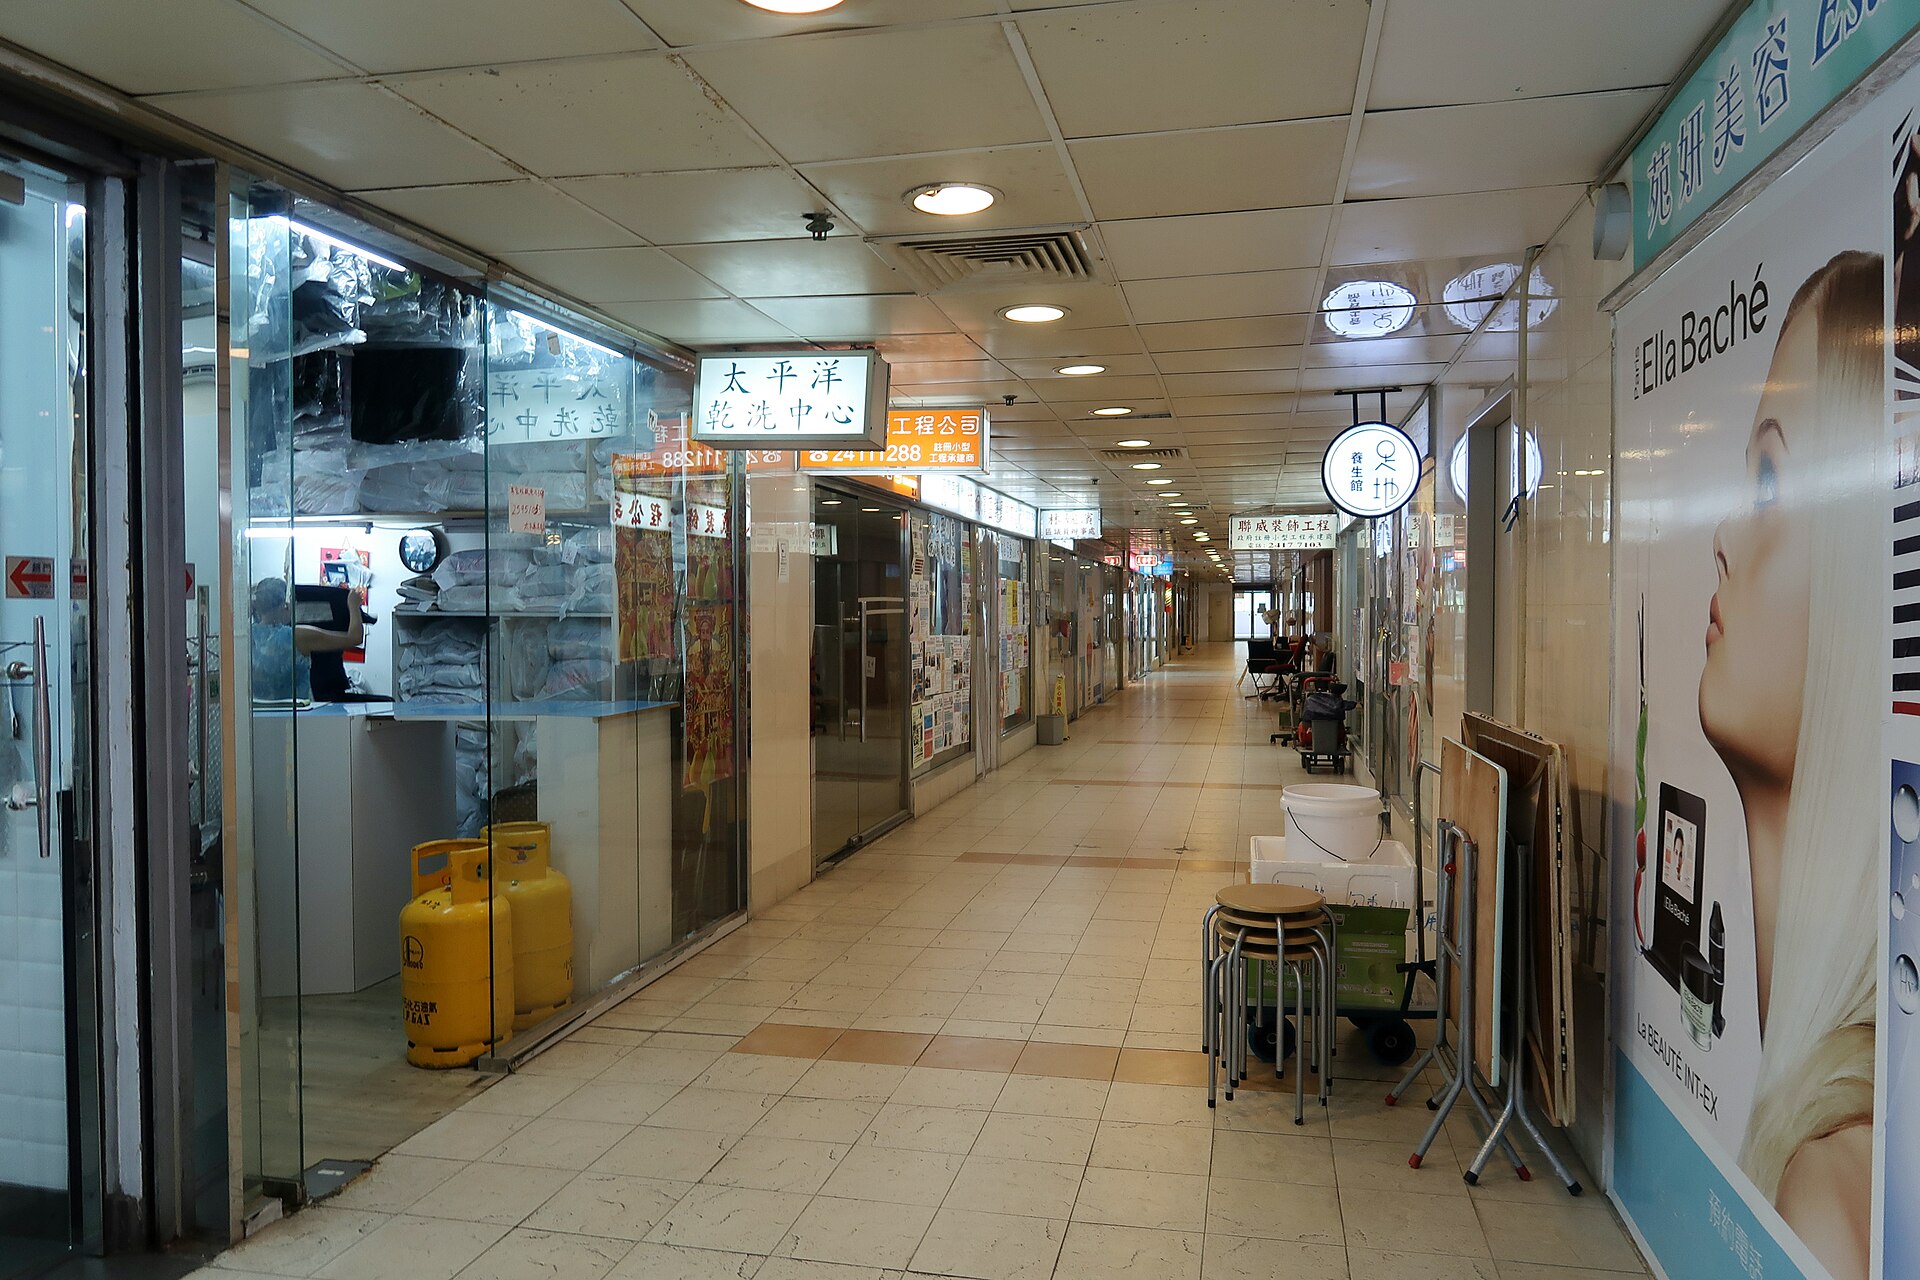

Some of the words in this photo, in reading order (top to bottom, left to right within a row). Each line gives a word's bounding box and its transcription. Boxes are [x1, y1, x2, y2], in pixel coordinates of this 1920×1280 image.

[1648, 16, 1790, 236] 苑妍美容
[1643, 337, 1676, 395] Ella
[1682, 262, 1769, 373] Baché
[720, 359, 842, 395] 太平洋
[706, 398, 854, 431] 乾洗中心
[886, 415, 980, 435] 工程公司
[929, 453, 975, 463] 工程承建商
[1350, 451, 1363, 492] 養生館
[1637, 1012, 1647, 1040] La
[1648, 1023, 1682, 1081] BEAUTÉ
[1684, 1063, 1718, 1121] INT-EX
